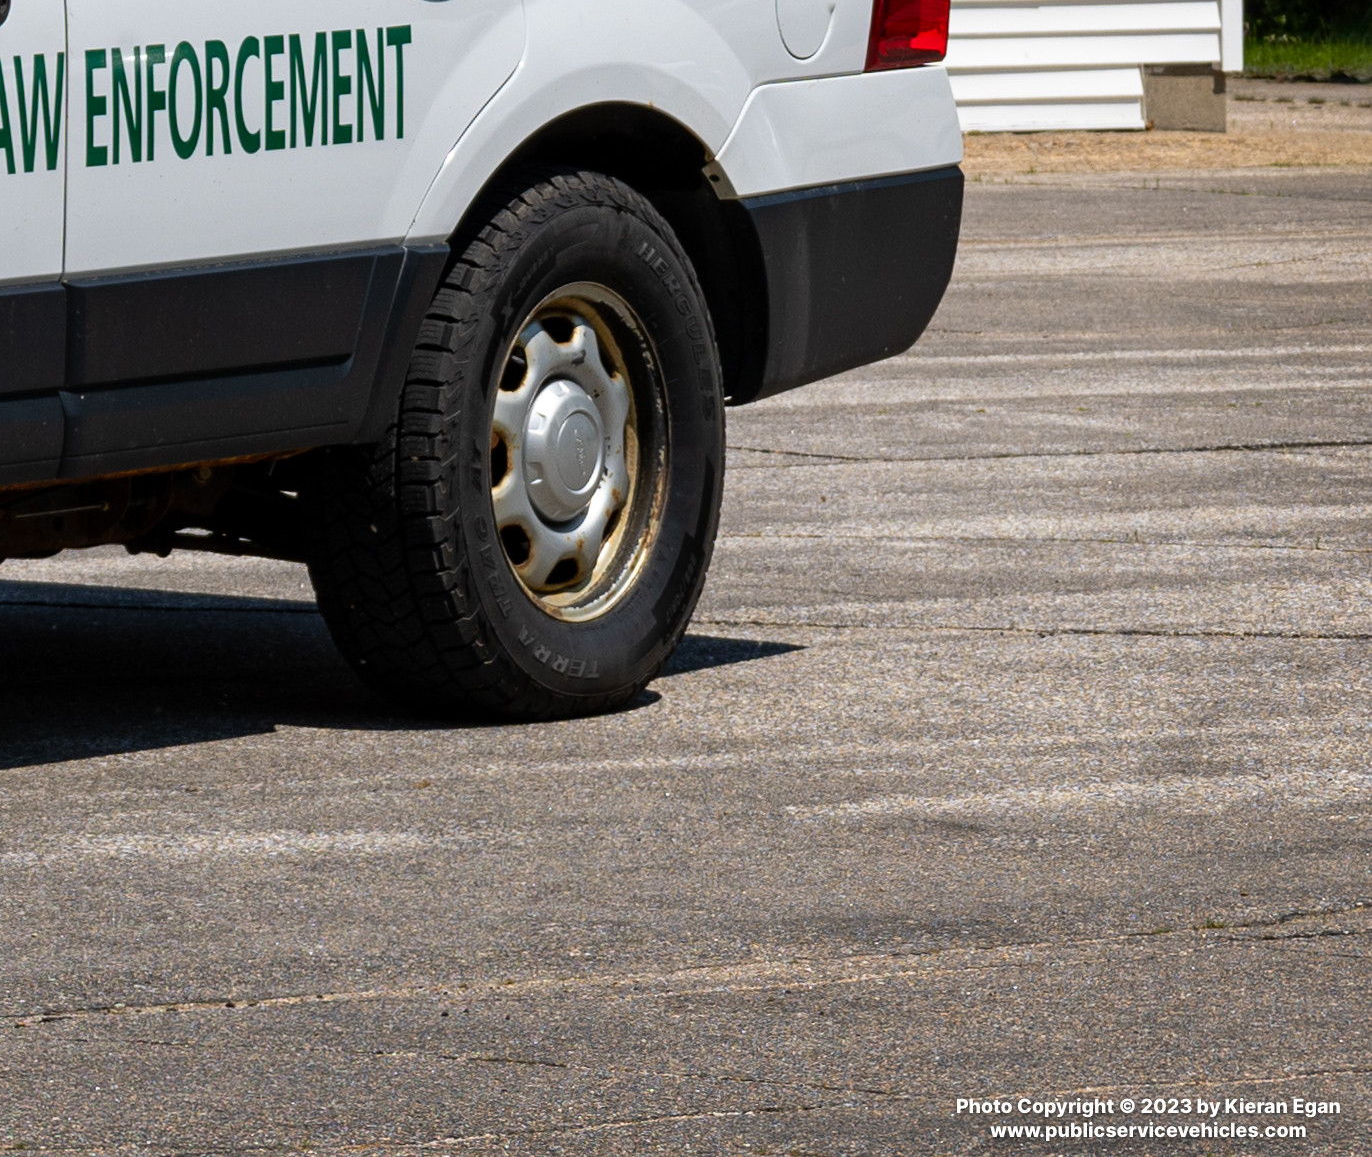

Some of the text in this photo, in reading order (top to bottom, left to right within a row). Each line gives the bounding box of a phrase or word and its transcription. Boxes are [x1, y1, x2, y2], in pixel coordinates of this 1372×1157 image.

[84, 24, 413, 168] ENFORCEMENT
[634, 241, 716, 422] HERCULES
[517, 624, 600, 679] TERRA
